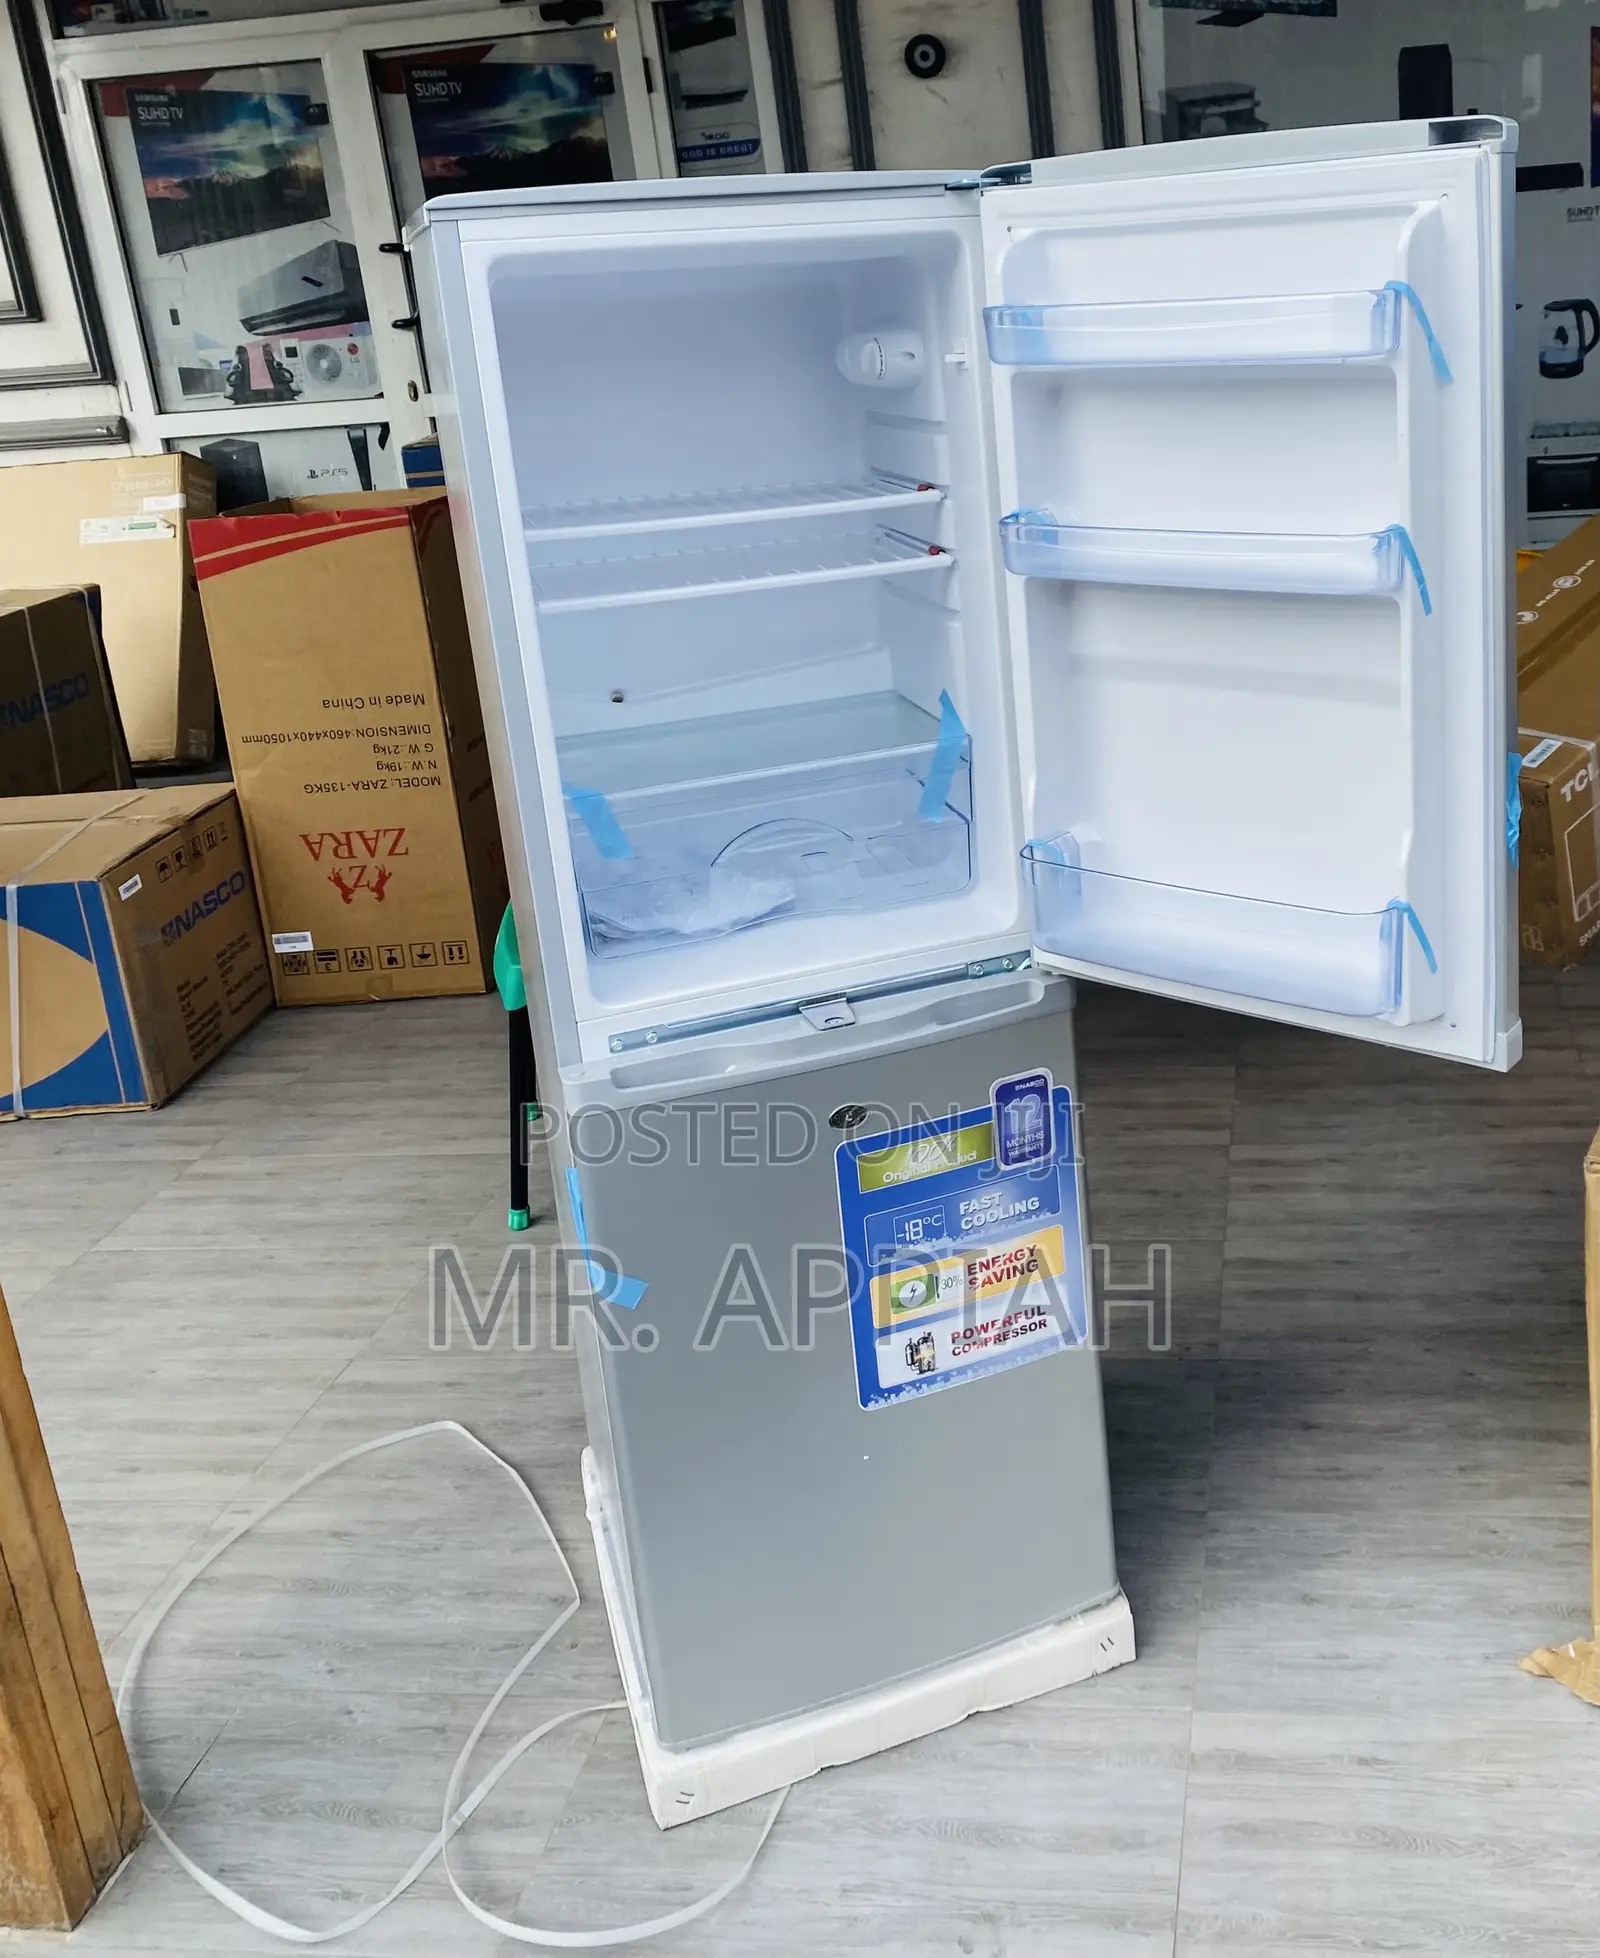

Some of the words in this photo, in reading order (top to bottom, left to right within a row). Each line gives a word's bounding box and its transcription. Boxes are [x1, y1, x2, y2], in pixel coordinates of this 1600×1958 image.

[322, 696, 365, 710] China
[369, 695, 382, 707] in
[386, 693, 426, 706] Made
[303, 780, 387, 795] ZARA-135KG
[390, 775, 441, 788] MODEL:
[299, 827, 409, 862] ZARA
[174, 869, 246, 939] NASCO
[1004, 1093, 1042, 1135] 12
[1006, 1130, 1046, 1149] MONTHS
[959, 1192, 1003, 1216] FAST
[960, 1196, 1040, 1230] COOLING
[967, 1244, 1037, 1276] ENERGY
[940, 1275, 963, 1291] 30%
[968, 1258, 1039, 1291] SAVING
[950, 1305, 1046, 1344] POWERFUL
[951, 1318, 1048, 1356] COMPRESSOR
